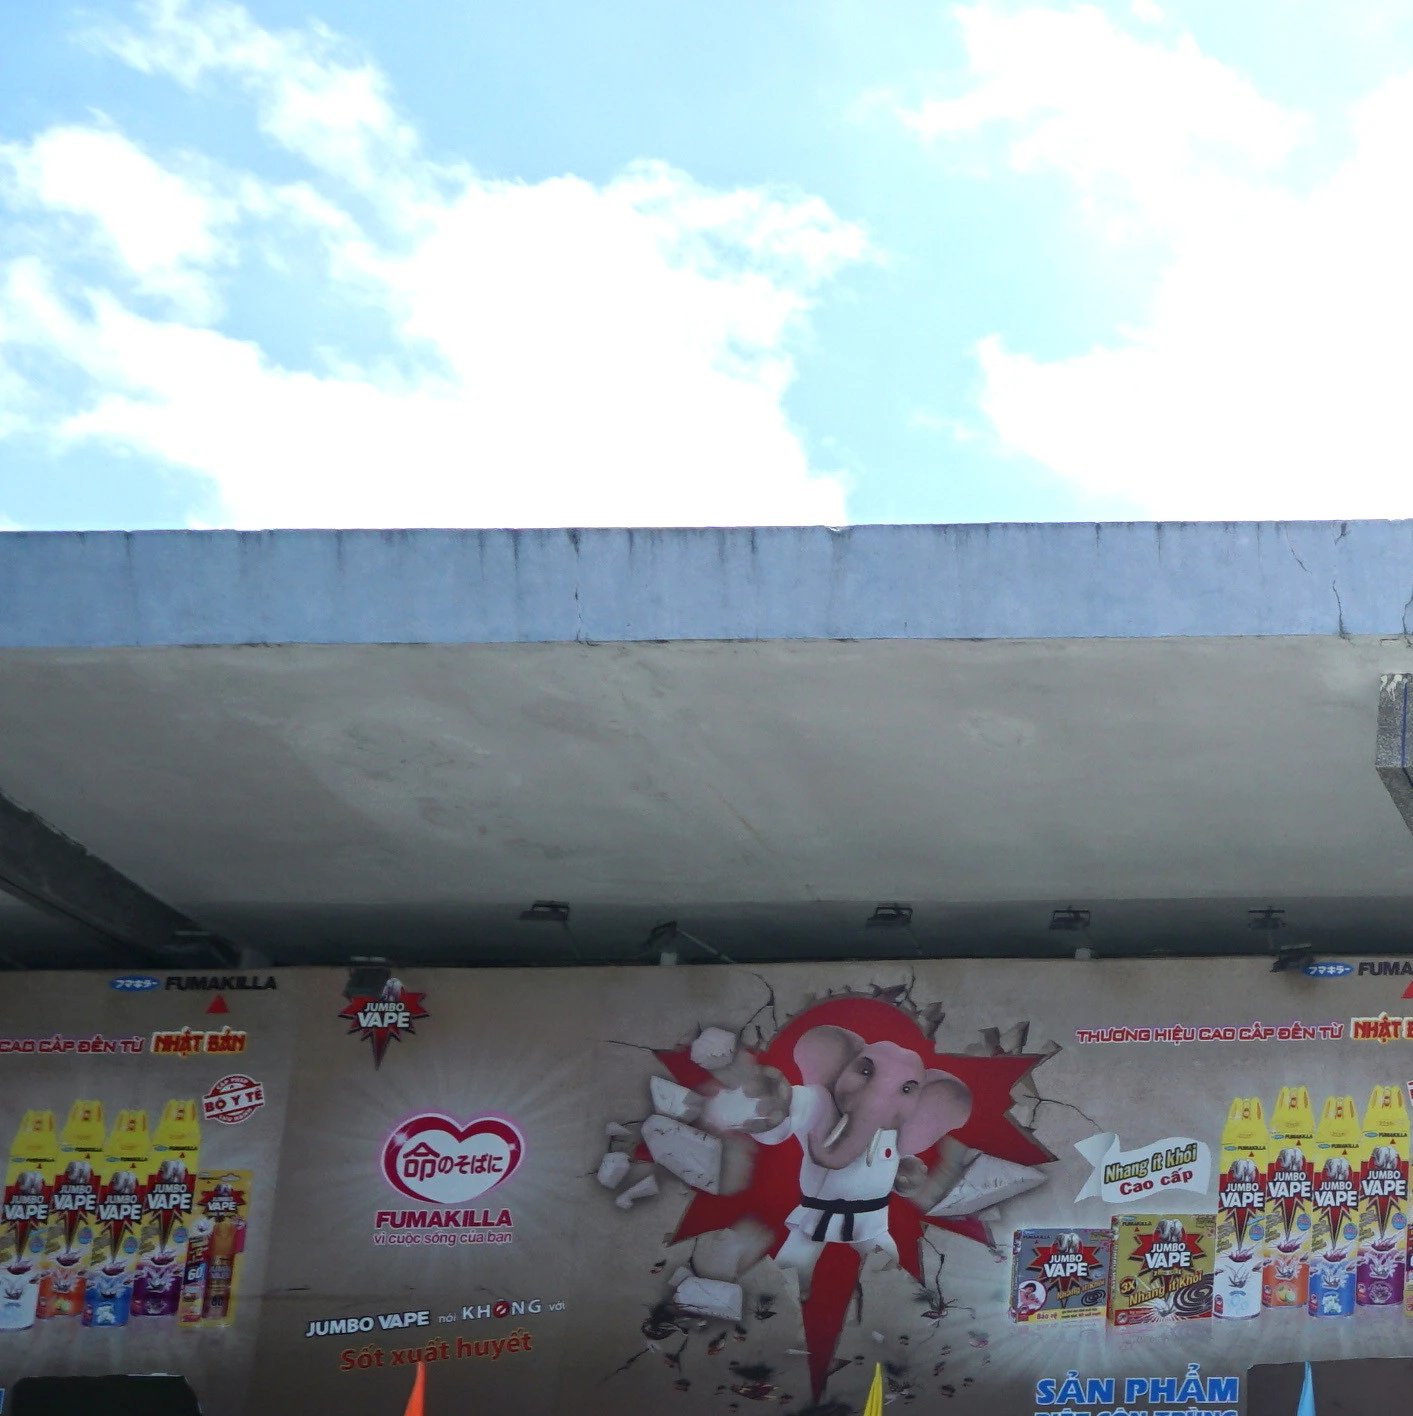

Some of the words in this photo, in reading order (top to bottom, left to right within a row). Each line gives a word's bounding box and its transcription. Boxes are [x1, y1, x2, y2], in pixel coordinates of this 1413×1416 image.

[165, 976, 278, 991] FUMAKILLA
[364, 1002, 405, 1012] JUMBO
[357, 1012, 411, 1028] VAPE
[1077, 1027, 1151, 1043] THƯƠNG
[1154, 1023, 1194, 1045] HIỆU
[1199, 1027, 1236, 1041] CAO
[1238, 1021, 1276, 1041] CẤP
[1277, 1022, 1316, 1040] ĐẾN
[1318, 1023, 1344, 1040] TỪ
[1351, 1011, 1401, 1044] NHẬT
[152, 1026, 203, 1057] NHẬT
[231, 1094, 241, 1106] Y
[402, 1141, 504, 1182] 命のそばに
[1104, 1157, 1149, 1184] Nhang
[1165, 1143, 1198, 1169] khói
[1119, 1179, 1154, 1196] Cao
[1160, 1167, 1194, 1187] cấp
[1273, 1172, 1306, 1181] JUMBO
[1367, 1170, 1401, 1180] JUMBO
[60, 1184, 93, 1194] JUMBO
[153, 1184, 187, 1193] JUMBO
[1226, 1183, 1259, 1192] JUMBO
[1268, 1181, 1311, 1198] VAPE
[1319, 1181, 1353, 1191] JUMBO
[1362, 1180, 1407, 1196] VAPE
[54, 1195, 97, 1210] VAPE
[105, 1195, 138, 1204] JUMBO
[147, 1194, 192, 1209] VAPE
[1220, 1192, 1264, 1208] VAPE
[1314, 1191, 1358, 1207] VAPE
[100, 1205, 142, 1220] VAPE
[375, 1208, 513, 1229] FUMAKILLA
[388, 1231, 421, 1246] cuộc
[424, 1229, 456, 1246] sống
[1150, 1242, 1186, 1253] JUMBO
[1048, 1254, 1083, 1263] JUMBO
[1144, 1252, 1193, 1269] VAPE
[1042, 1263, 1089, 1278] VAPE
[1120, 1279, 1137, 1291] 3X
[1128, 1285, 1166, 1307] Nhang
[305, 1318, 375, 1338] JUMBO
[379, 1310, 431, 1331] VAPE
[340, 1342, 384, 1371] Sốt
[391, 1336, 450, 1366] xuất
[456, 1327, 533, 1360] huyết
[1036, 1370, 1115, 1405] SẢN
[1124, 1363, 1239, 1403] PHẨM
